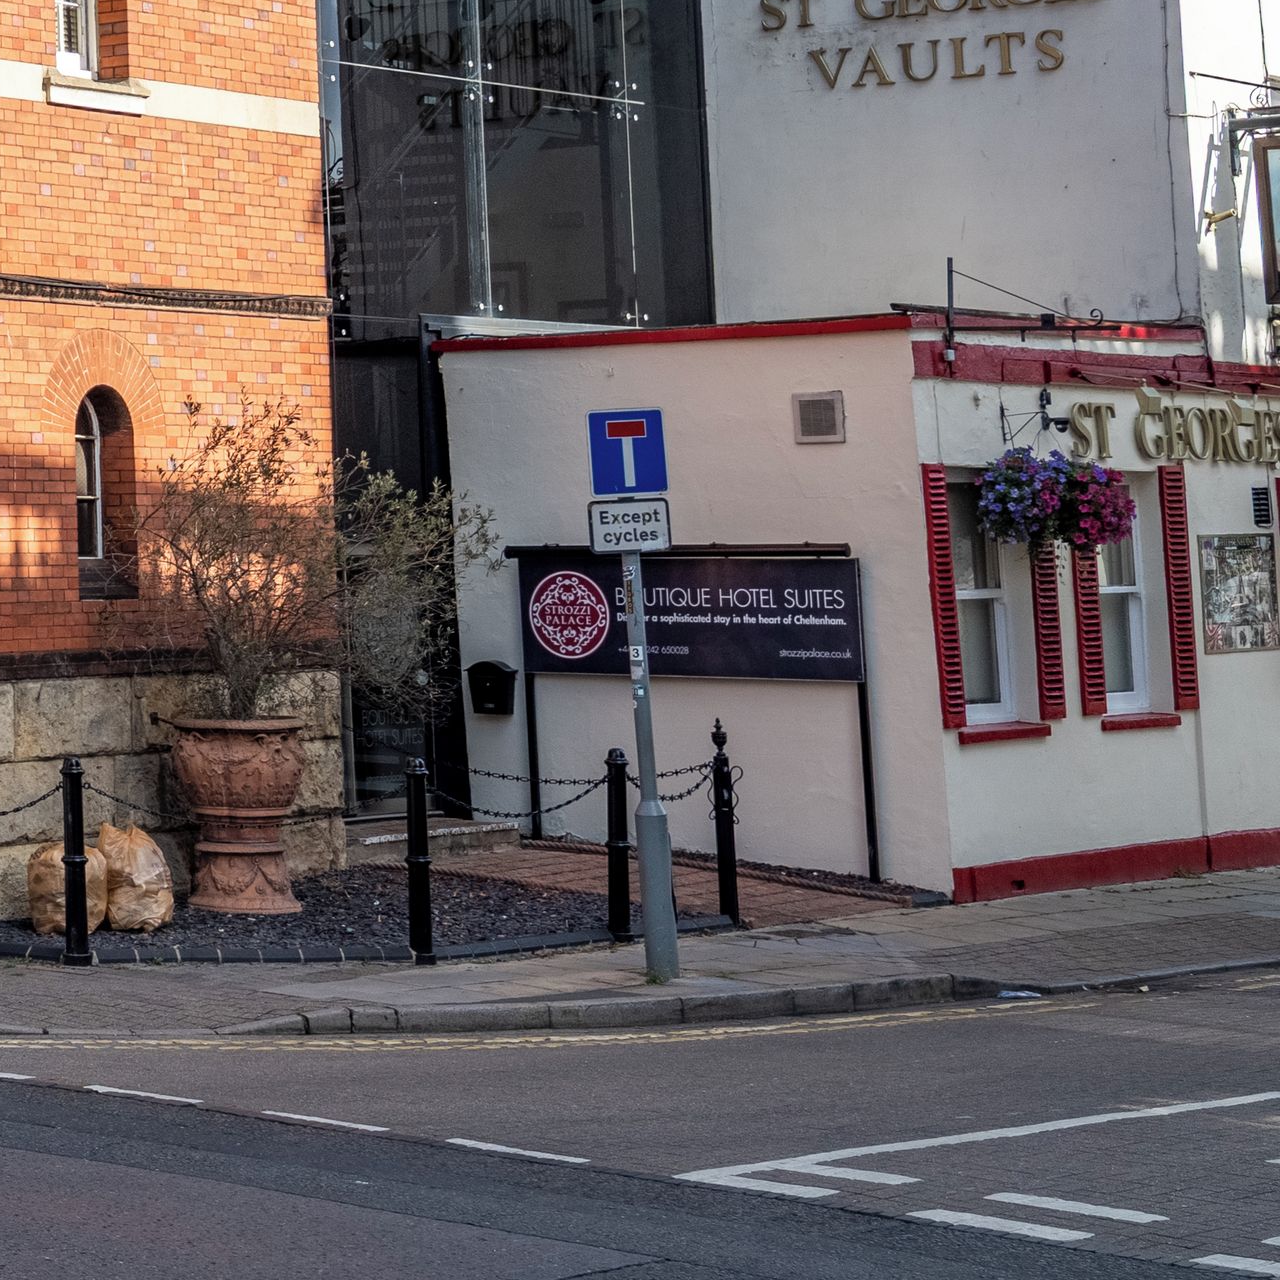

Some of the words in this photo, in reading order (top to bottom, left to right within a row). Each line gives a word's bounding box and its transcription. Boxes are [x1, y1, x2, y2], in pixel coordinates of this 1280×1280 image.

[807, 28, 1065, 89] VAULTS
[1070, 402, 1117, 459] ST
[599, 509, 661, 526] Except
[603, 528, 659, 545] cycles
[615, 587, 711, 607] BUTIQUE
[719, 588, 777, 608] HOTEL
[784, 588, 845, 609] SUITES
[544, 604, 591, 615] STROZZI
[545, 615, 592, 625] PALACE
[660, 613, 711, 624] sophisticated
[713, 615, 731, 626] stay
[733, 614, 741, 624] in
[743, 614, 756, 624] the
[758, 614, 781, 625] heart
[783, 614, 792, 625] of
[793, 614, 847, 626] Cheltenham.
[632, 648, 640, 658] 3
[661, 646, 690, 655] 650028
[779, 648, 853, 660] strozzipalace.co.uk
